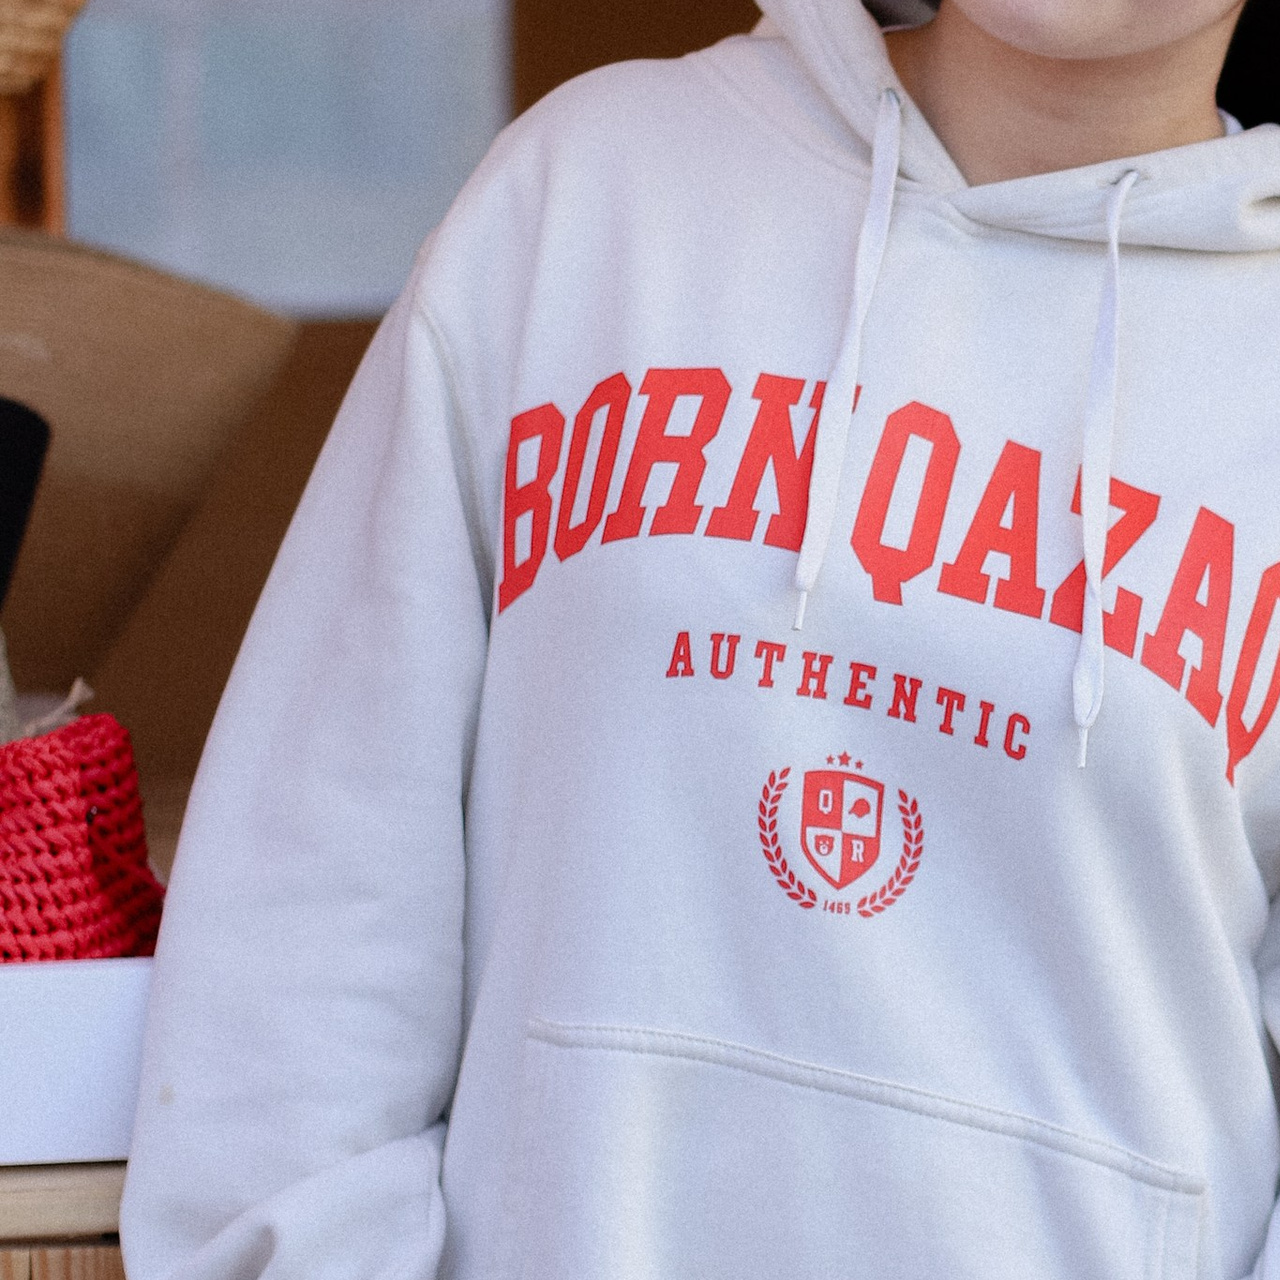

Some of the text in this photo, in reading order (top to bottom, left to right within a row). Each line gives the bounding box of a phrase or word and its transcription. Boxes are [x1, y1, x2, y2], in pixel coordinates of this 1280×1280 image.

[497, 367, 862, 615] BORN
[665, 631, 1032, 762] AUTHENTIC
[818, 788, 834, 815] Q
[851, 839, 866, 863] R
